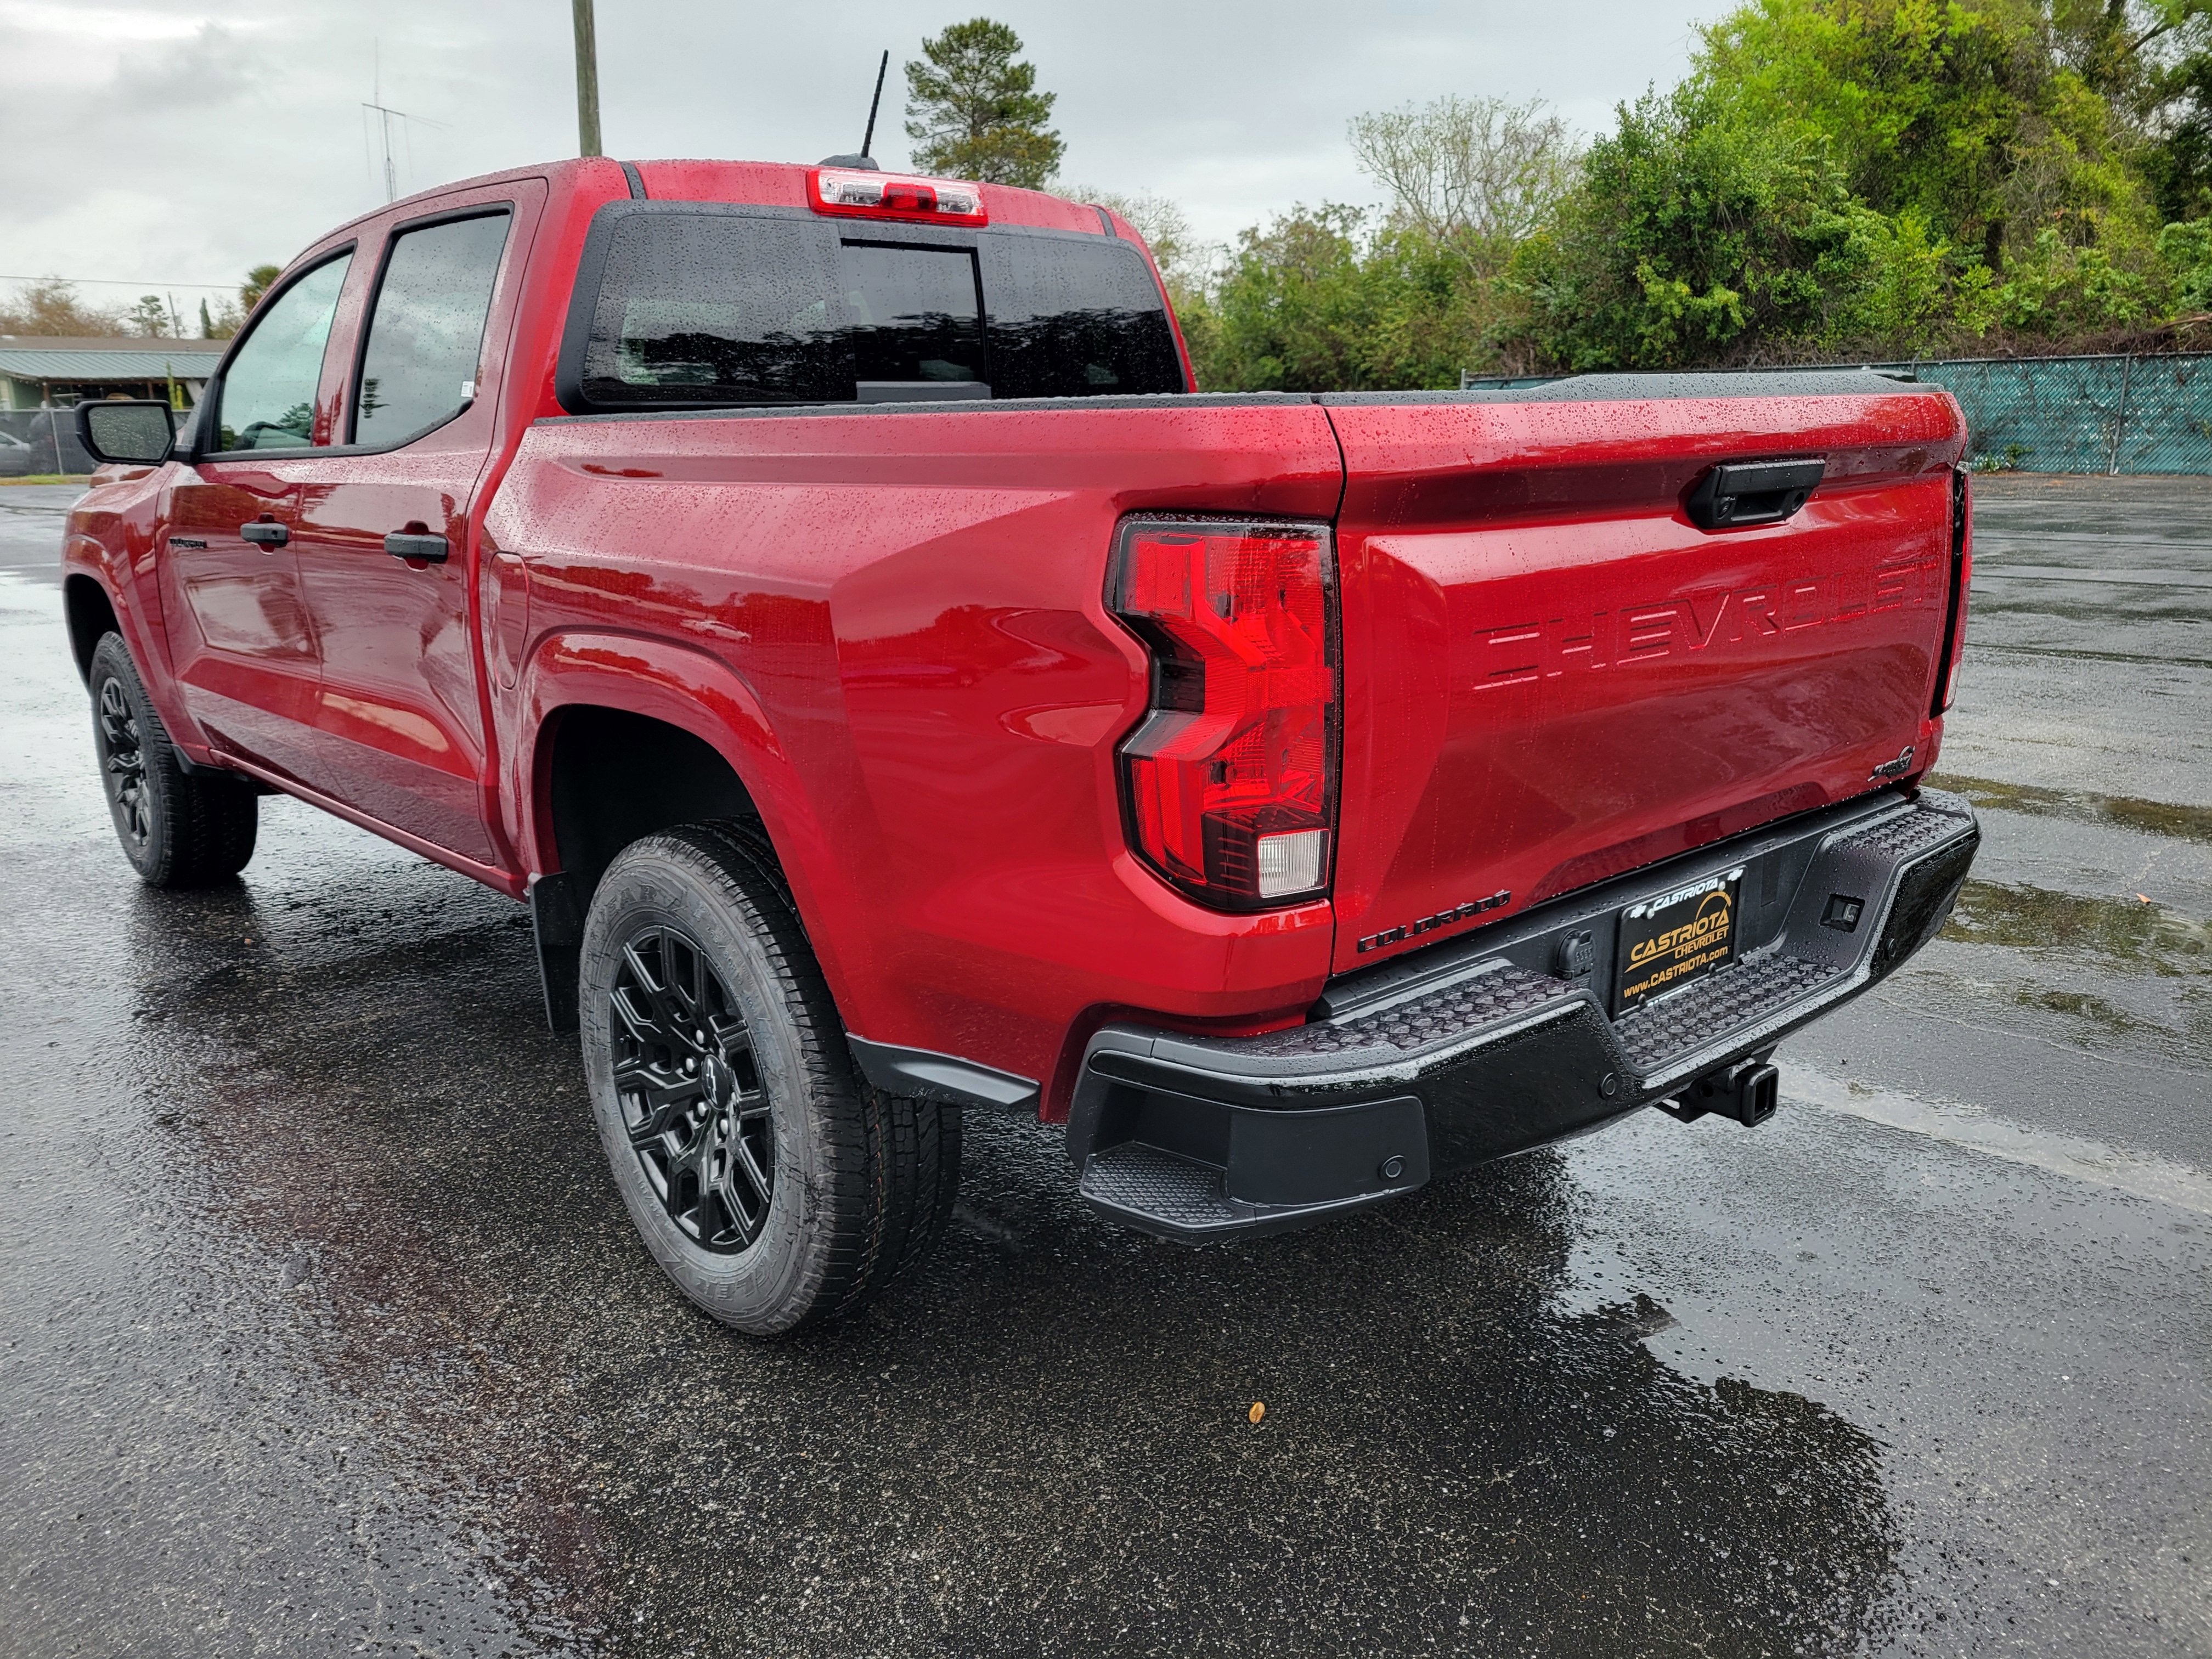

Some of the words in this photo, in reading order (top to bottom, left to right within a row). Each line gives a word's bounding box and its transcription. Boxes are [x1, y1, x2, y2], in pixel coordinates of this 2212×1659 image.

[1472, 555, 1938, 690] CHEVROLET
[1653, 878, 1718, 911] CASTRIOTA
[1358, 890, 1511, 953] COLORADO
[1631, 909, 1729, 961] CASTRIOTA
[1675, 928, 1728, 959] CHEVROLET
[1624, 946, 1728, 998] www.CASTRIOTA.com
